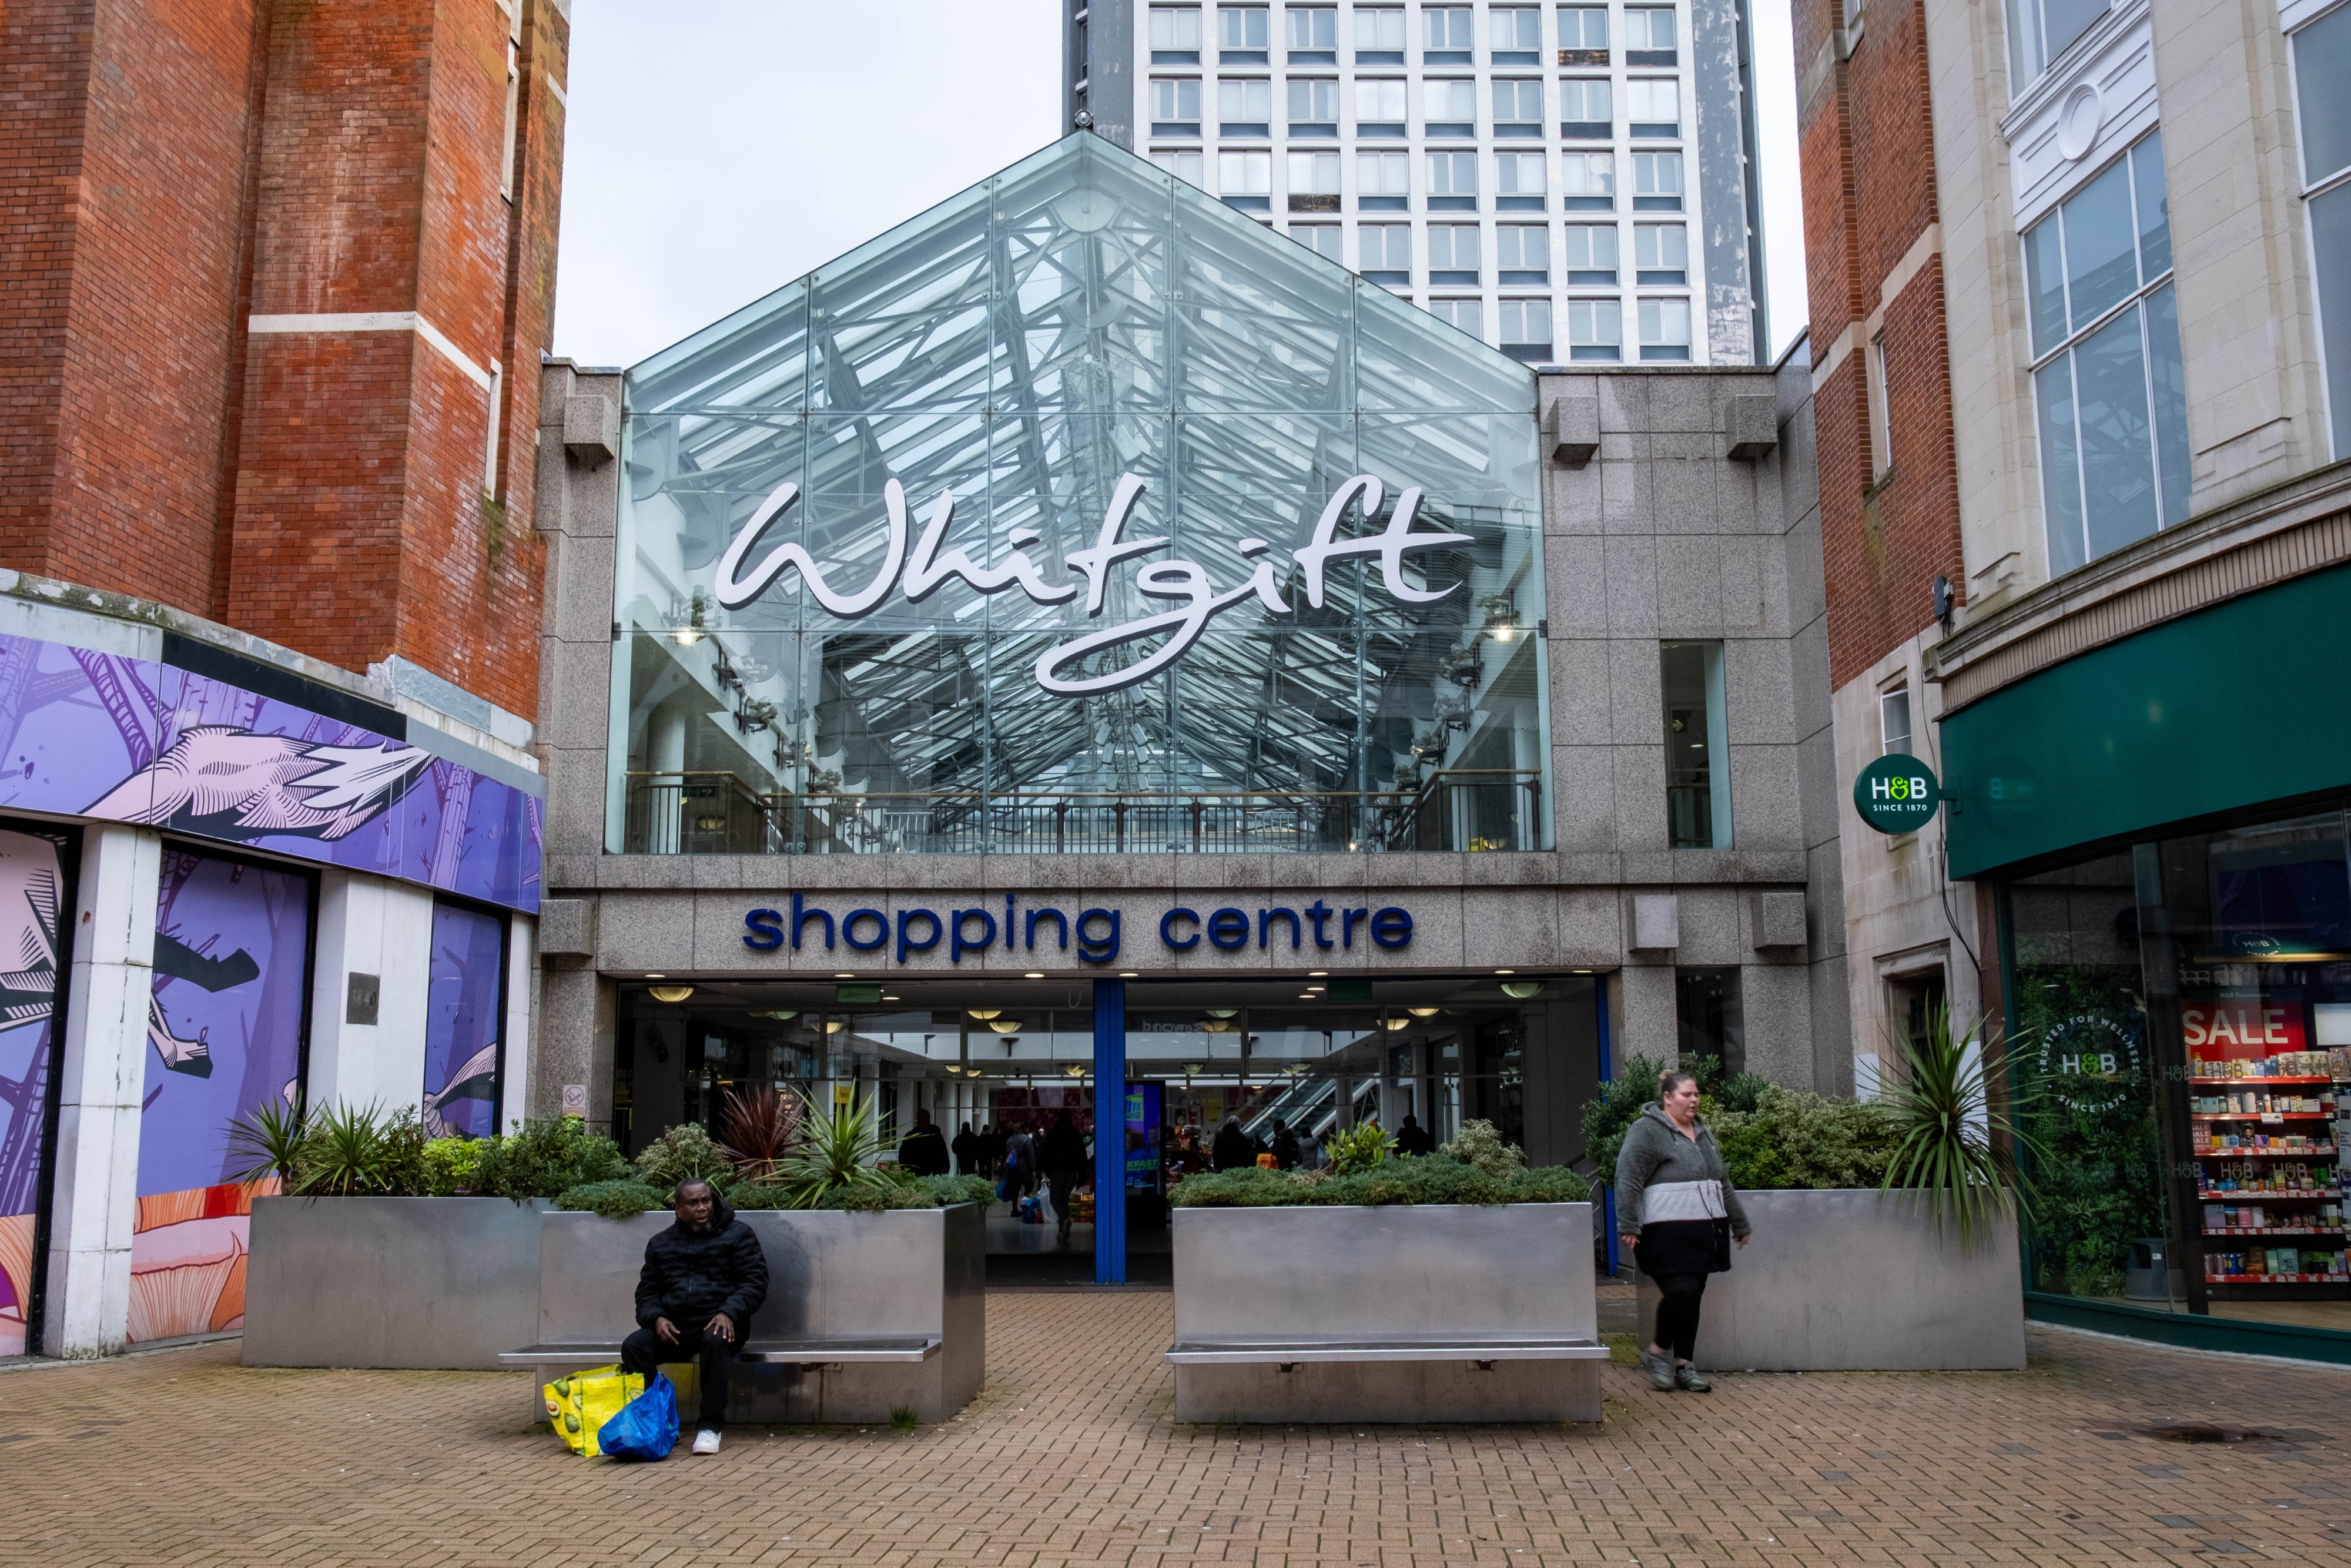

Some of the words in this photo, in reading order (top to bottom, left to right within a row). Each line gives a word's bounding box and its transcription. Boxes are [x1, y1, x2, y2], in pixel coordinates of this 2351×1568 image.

[715, 472, 1475, 696] Whitgift
[1871, 776, 1927, 800] H&B
[742, 893, 1121, 963] shopping
[1160, 899, 1413, 949] centre
[2182, 1009, 2288, 1046] SALE
[2039, 1023, 2065, 1074] TRUSTED
[2069, 1015, 2094, 1026] FOR
[2101, 1017, 2140, 1071] WELLNESS
[2062, 1053, 2116, 1074] H&B
[2058, 1094, 2096, 1113] SINCE
[2101, 1094, 2126, 1111] 1870
[2172, 1161, 2203, 1178] H&B
[2221, 1161, 2254, 1180] H&B
[2273, 1162, 2309, 1180] H&B
